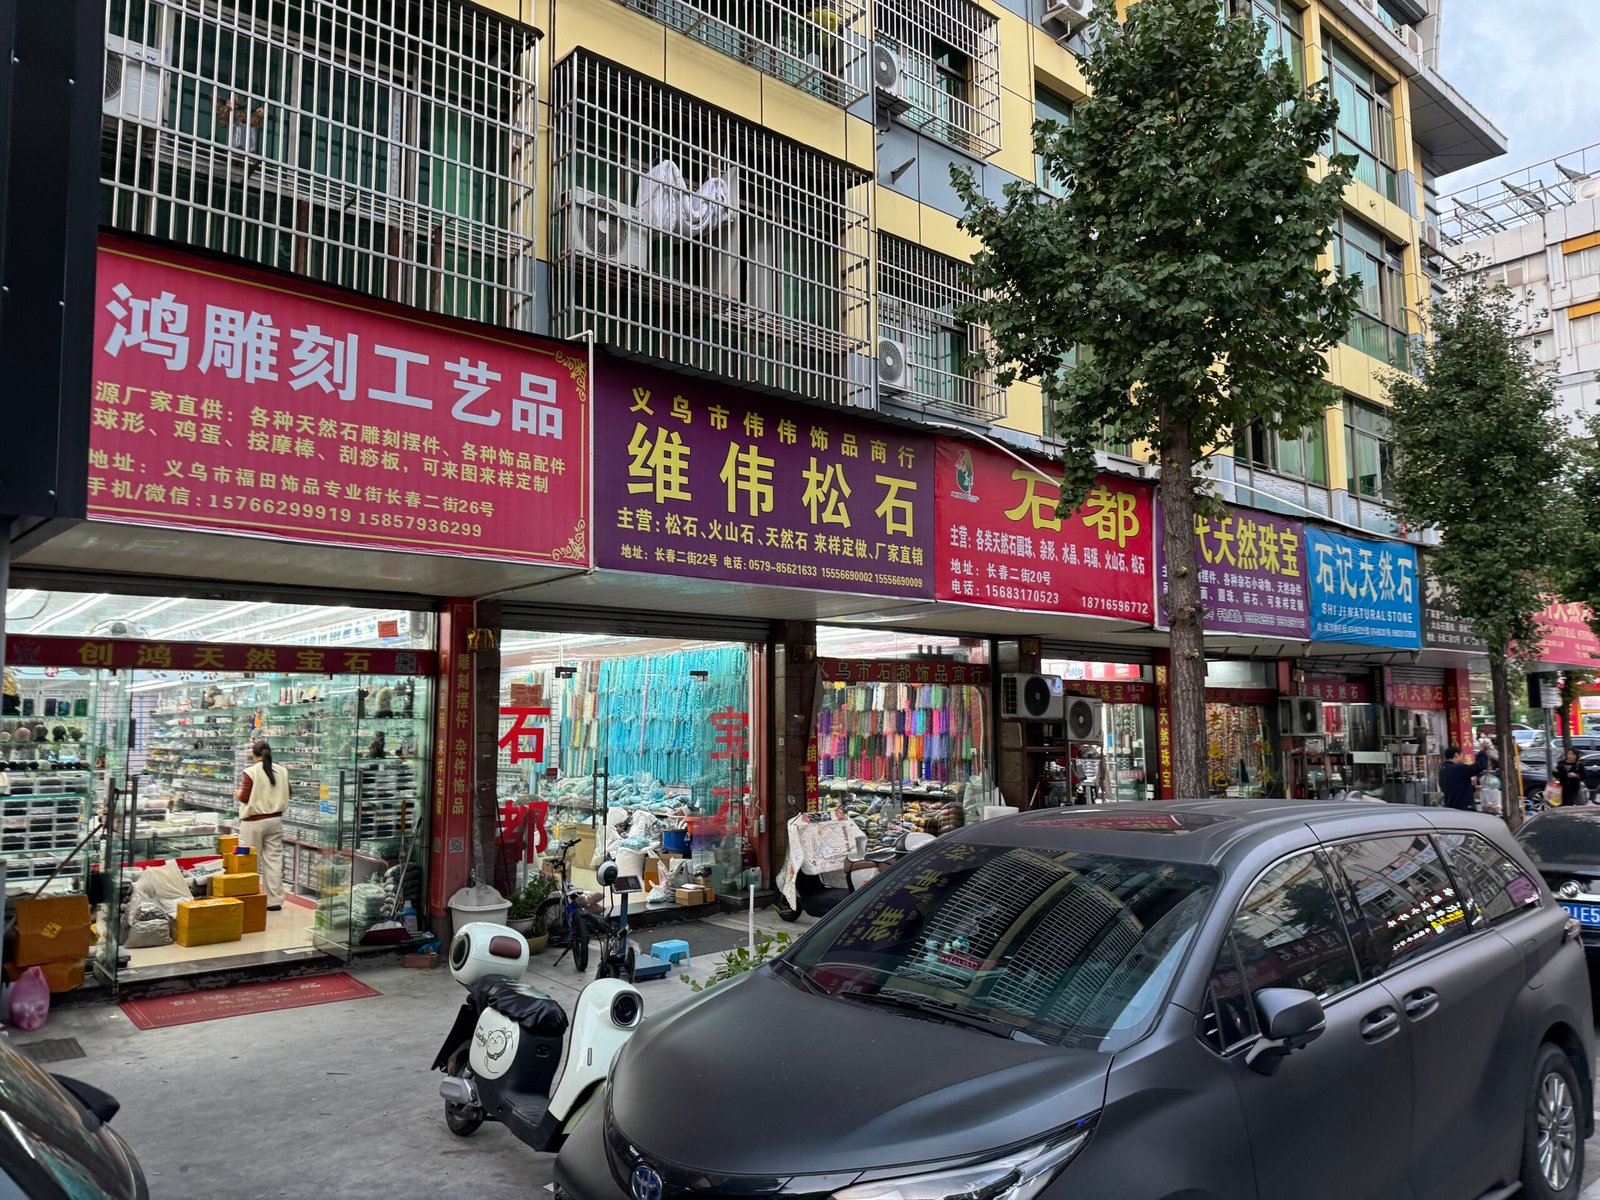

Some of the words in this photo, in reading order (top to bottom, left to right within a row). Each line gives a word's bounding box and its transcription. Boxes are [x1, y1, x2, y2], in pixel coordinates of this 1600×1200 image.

[104, 282, 563, 440] 鸿雕刻工艺品
[629, 387, 915, 470] 义乌市伟伟饰品商行
[627, 422, 918, 537] 维伟松石
[1003, 468, 1140, 549] 石都
[358, 511, 483, 537] 15857936299
[1163, 513, 1300, 577] 代天然珠宝
[821, 567, 873, 583] 15556690002
[874, 573, 923, 588] 15556690009
[1314, 543, 1413, 604] 石记天然石
[1081, 596, 1149, 615] 18716596772
[1321, 602, 1337, 616] SHI
[1338, 605, 1347, 617] JI
[1347, 606, 1387, 621] NATURAL
[1387, 610, 1414, 624] STONE
[78, 641, 372, 673] 创鸿天然宝石
[817, 660, 984, 684] 义乌市石都饰品商行
[1156, 665, 1171, 788] 时代天然珠宝
[497, 706, 551, 864] 石都
